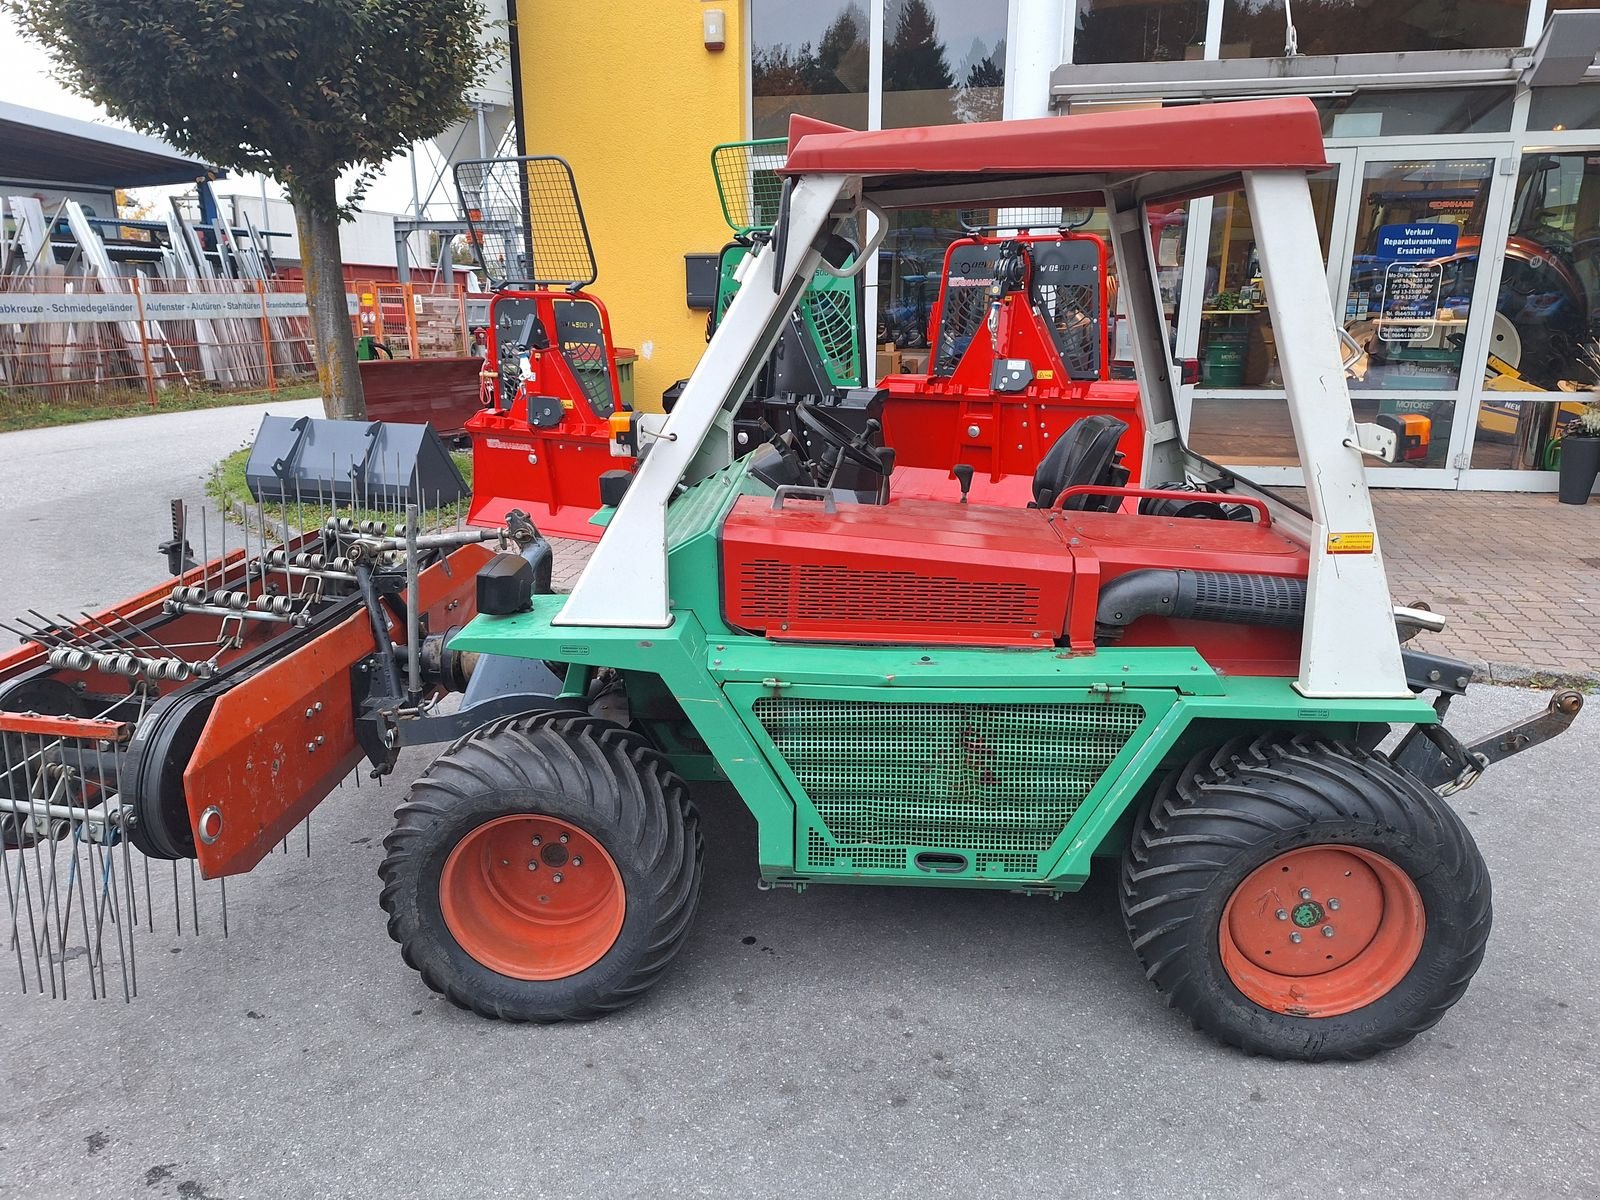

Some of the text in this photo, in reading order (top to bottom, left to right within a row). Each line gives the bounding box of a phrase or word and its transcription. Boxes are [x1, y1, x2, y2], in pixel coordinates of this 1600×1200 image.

[1404, 228, 1434, 236] Verkauf
[1383, 237, 1452, 246] Reparaturannahme
[1396, 247, 1436, 255] Ersatzteile
[52, 303, 133, 314] Schmiedegeländer
[146, 302, 185, 312] Alufenster
[191, 302, 221, 310] Alutüren
[227, 301, 261, 310] Stahltüren
